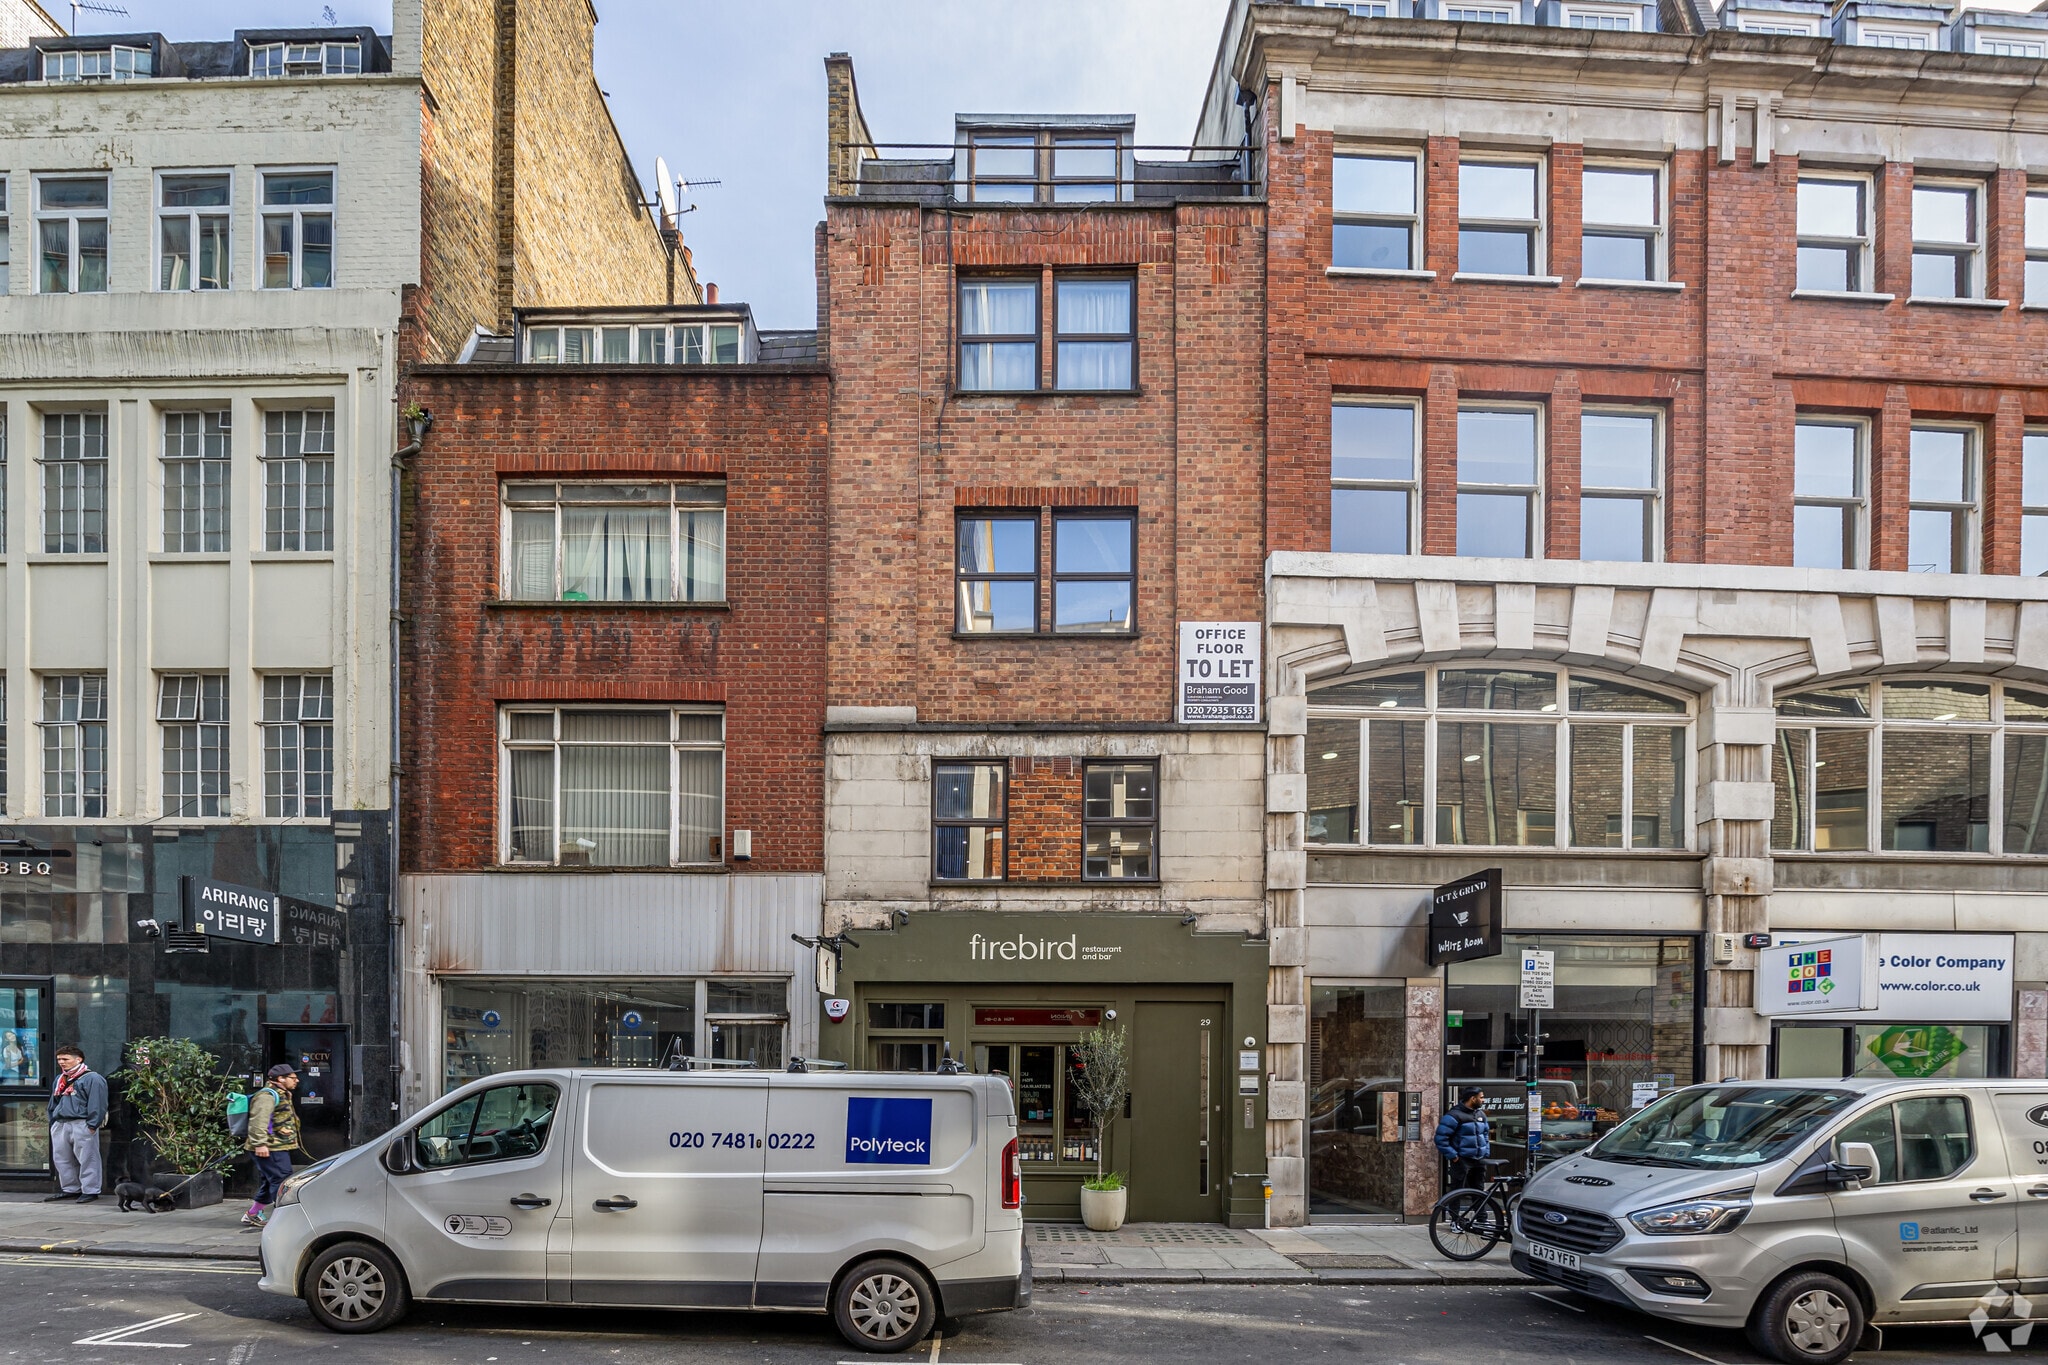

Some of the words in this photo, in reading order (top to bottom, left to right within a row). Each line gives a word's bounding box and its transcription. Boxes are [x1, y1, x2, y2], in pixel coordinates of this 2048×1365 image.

[1195, 629, 1246, 640] OFFICE
[1197, 643, 1244, 654] FLOOR
[1186, 659, 1212, 678] TO
[1218, 659, 1254, 678] LET
[1186, 685, 1221, 695] Braham
[1222, 685, 1248, 695] Good
[1186, 706, 1204, 715] 020
[1206, 706, 1229, 715] 7935
[1231, 706, 1254, 715] 1653
[202, 886, 269, 913] ARIRANG
[1436, 892, 1452, 904] CUT
[1452, 890, 1459, 900] &
[1459, 881, 1487, 897] GRIND
[203, 909, 268, 937] 아리랑
[969, 933, 1076, 961] firebird
[1438, 940, 1462, 953] WHITE
[1464, 937, 1484, 949] ROOM
[1528, 960, 1534, 969] P
[1791, 950, 1828, 966] THE
[1890, 955, 1931, 968] Color
[1936, 955, 2006, 971] Company
[1880, 980, 1980, 991] www.color.co.uk
[1412, 990, 1433, 1005] 28
[2024, 994, 2044, 1007] 27
[1914, 1049, 1950, 1076] CAPTURE
[669, 1132, 705, 1149] 020
[711, 1132, 755, 1149] 7481
[768, 1133, 816, 1150] 0222
[851, 1137, 926, 1154] Polyteck
[1921, 1226, 1979, 1235] @atlantic_Ltd
[1533, 1244, 1555, 1261] EA73
[1556, 1253, 1576, 1267] YFR
